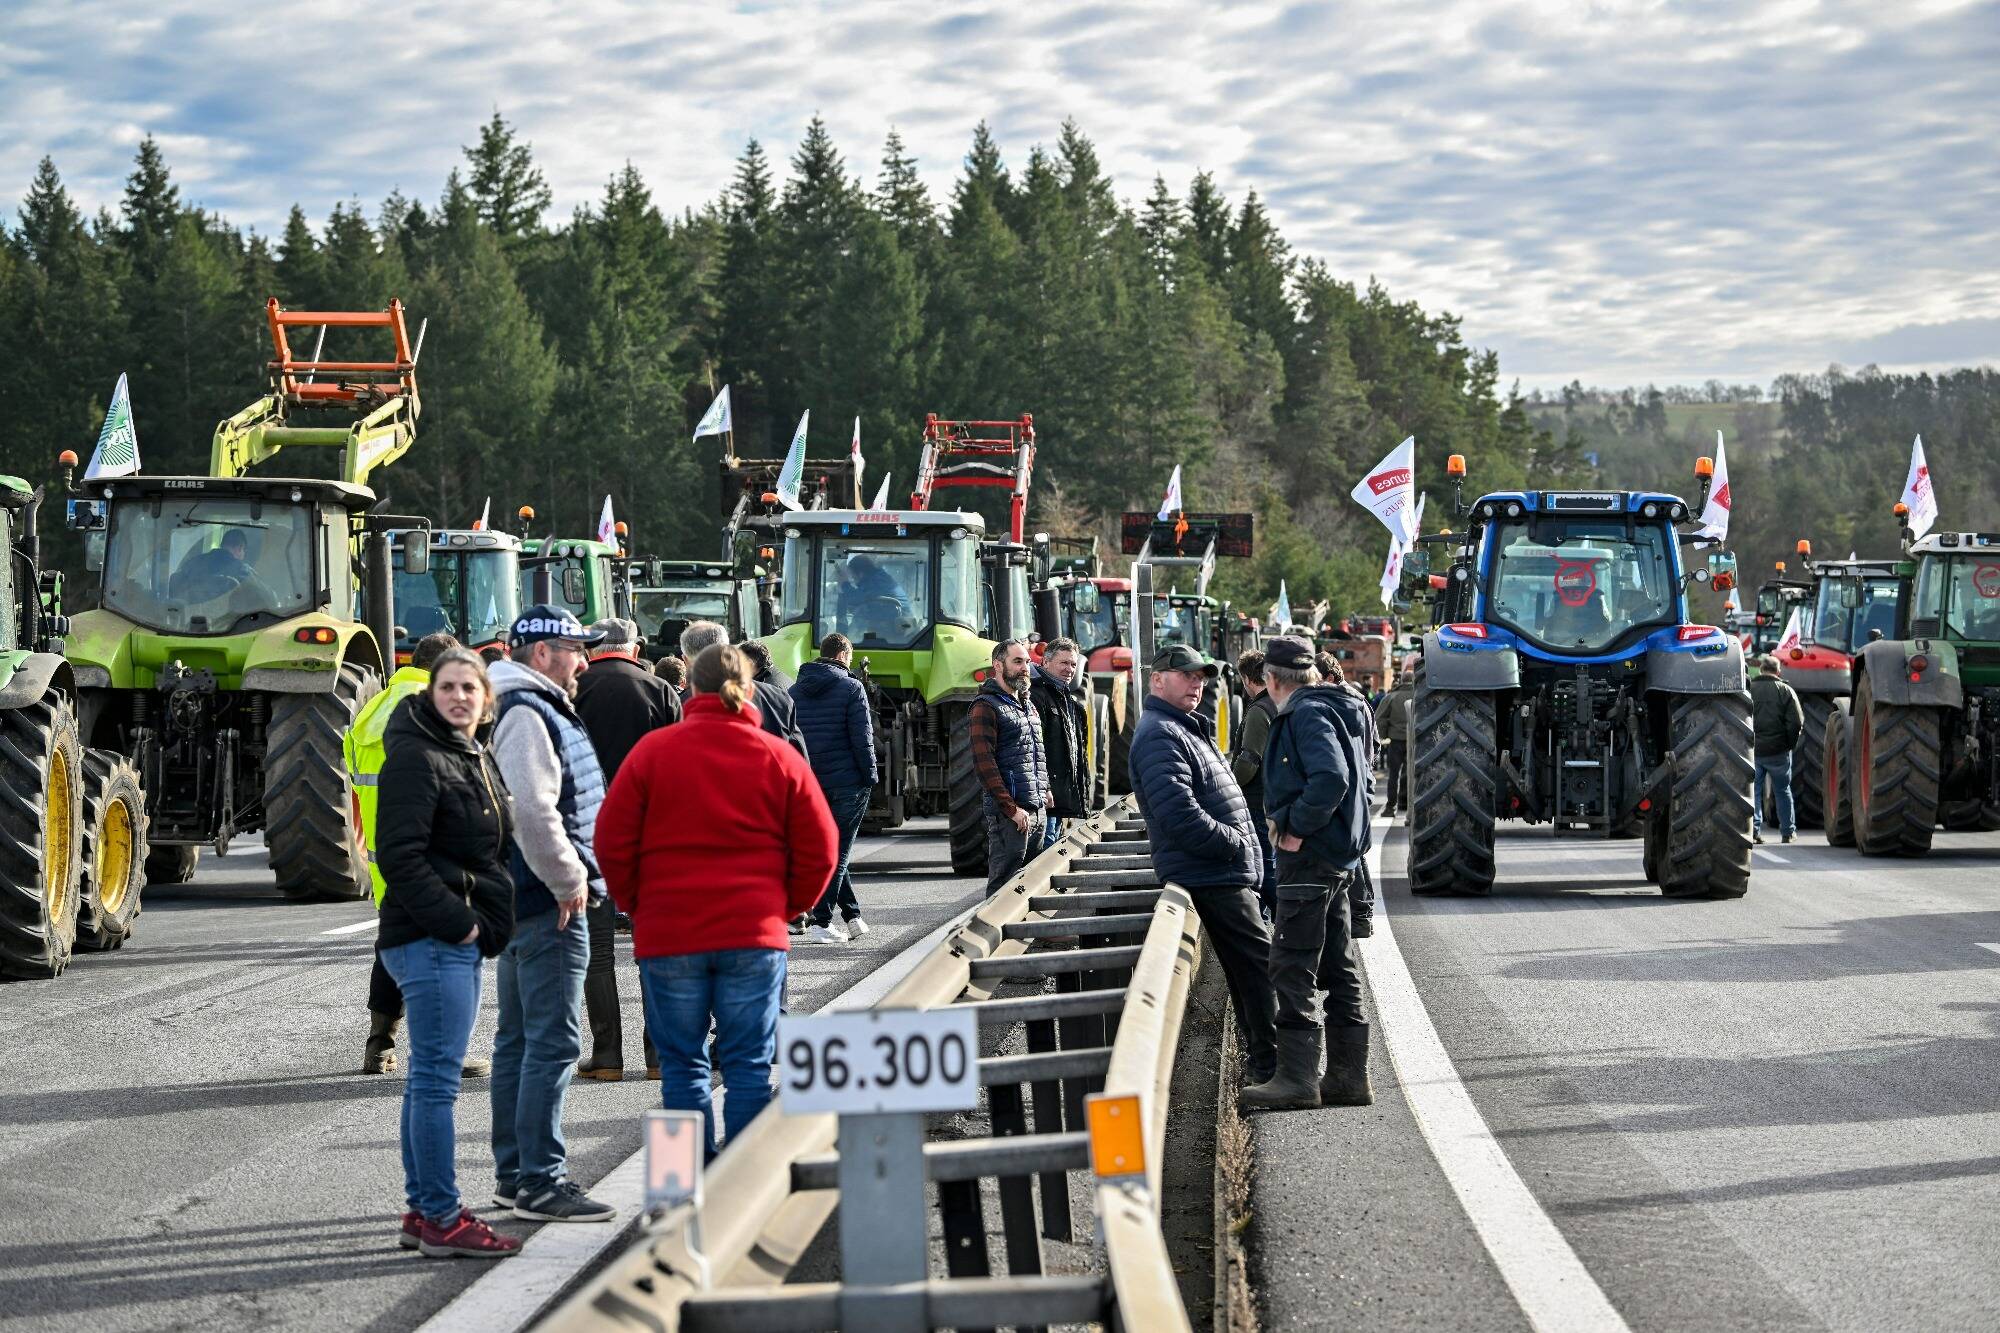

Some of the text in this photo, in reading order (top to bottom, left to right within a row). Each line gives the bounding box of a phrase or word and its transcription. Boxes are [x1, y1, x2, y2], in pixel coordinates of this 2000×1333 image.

[164, 480, 205, 489] CLAAS
[856, 513, 900, 522] CLAAS
[516, 617, 590, 636] canta
[788, 1033, 967, 1091] 96.300
